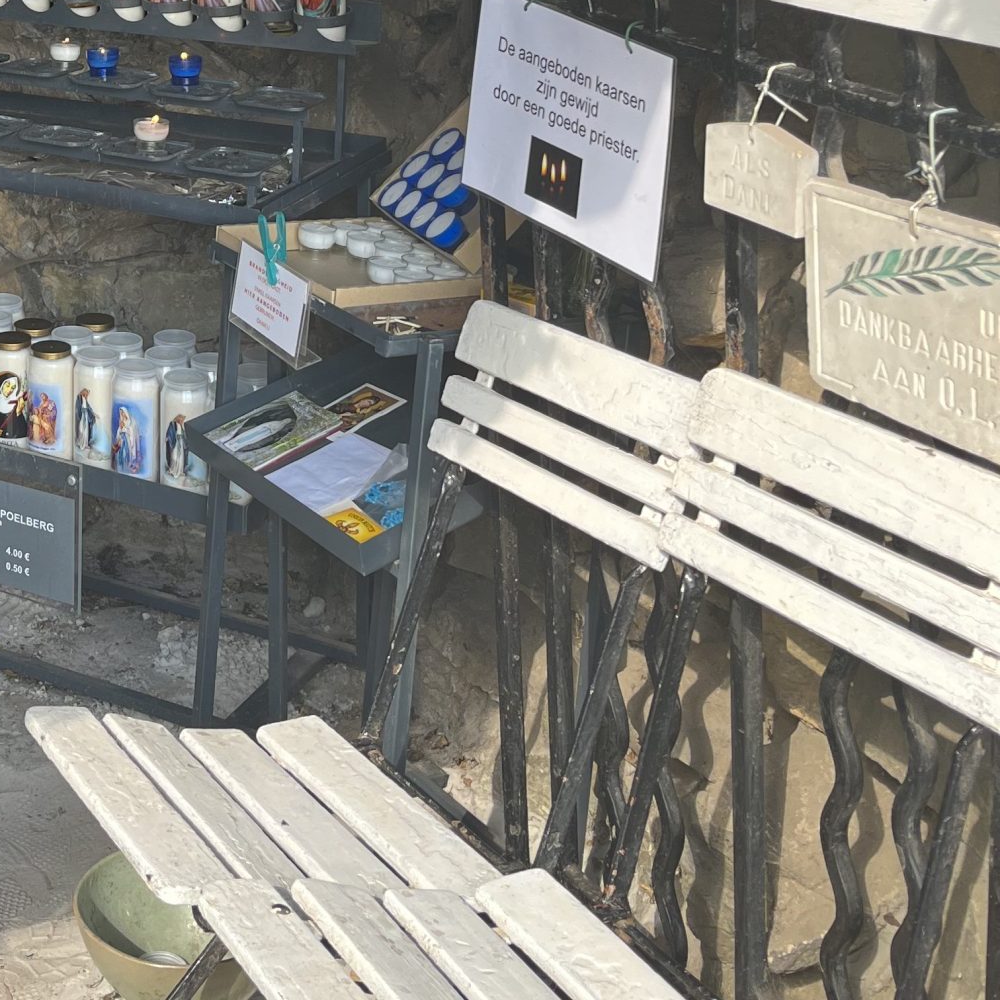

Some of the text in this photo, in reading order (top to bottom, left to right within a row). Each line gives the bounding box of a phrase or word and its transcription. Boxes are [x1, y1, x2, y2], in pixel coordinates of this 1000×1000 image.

[498, 36, 646, 112] De aangeboden kaarsen
[536, 79, 598, 117] zijn gewijd
[493, 85, 640, 163] door een goede priester.
[731, 144, 769, 178] ALS
[872, 357, 926, 400] AAN
[0, 509, 55, 533] POELBERG
[6, 546, 23, 559] 4.00
[24, 553, 30, 562] €
[6, 562, 23, 574] 0.50
[24, 568, 30, 577] €
